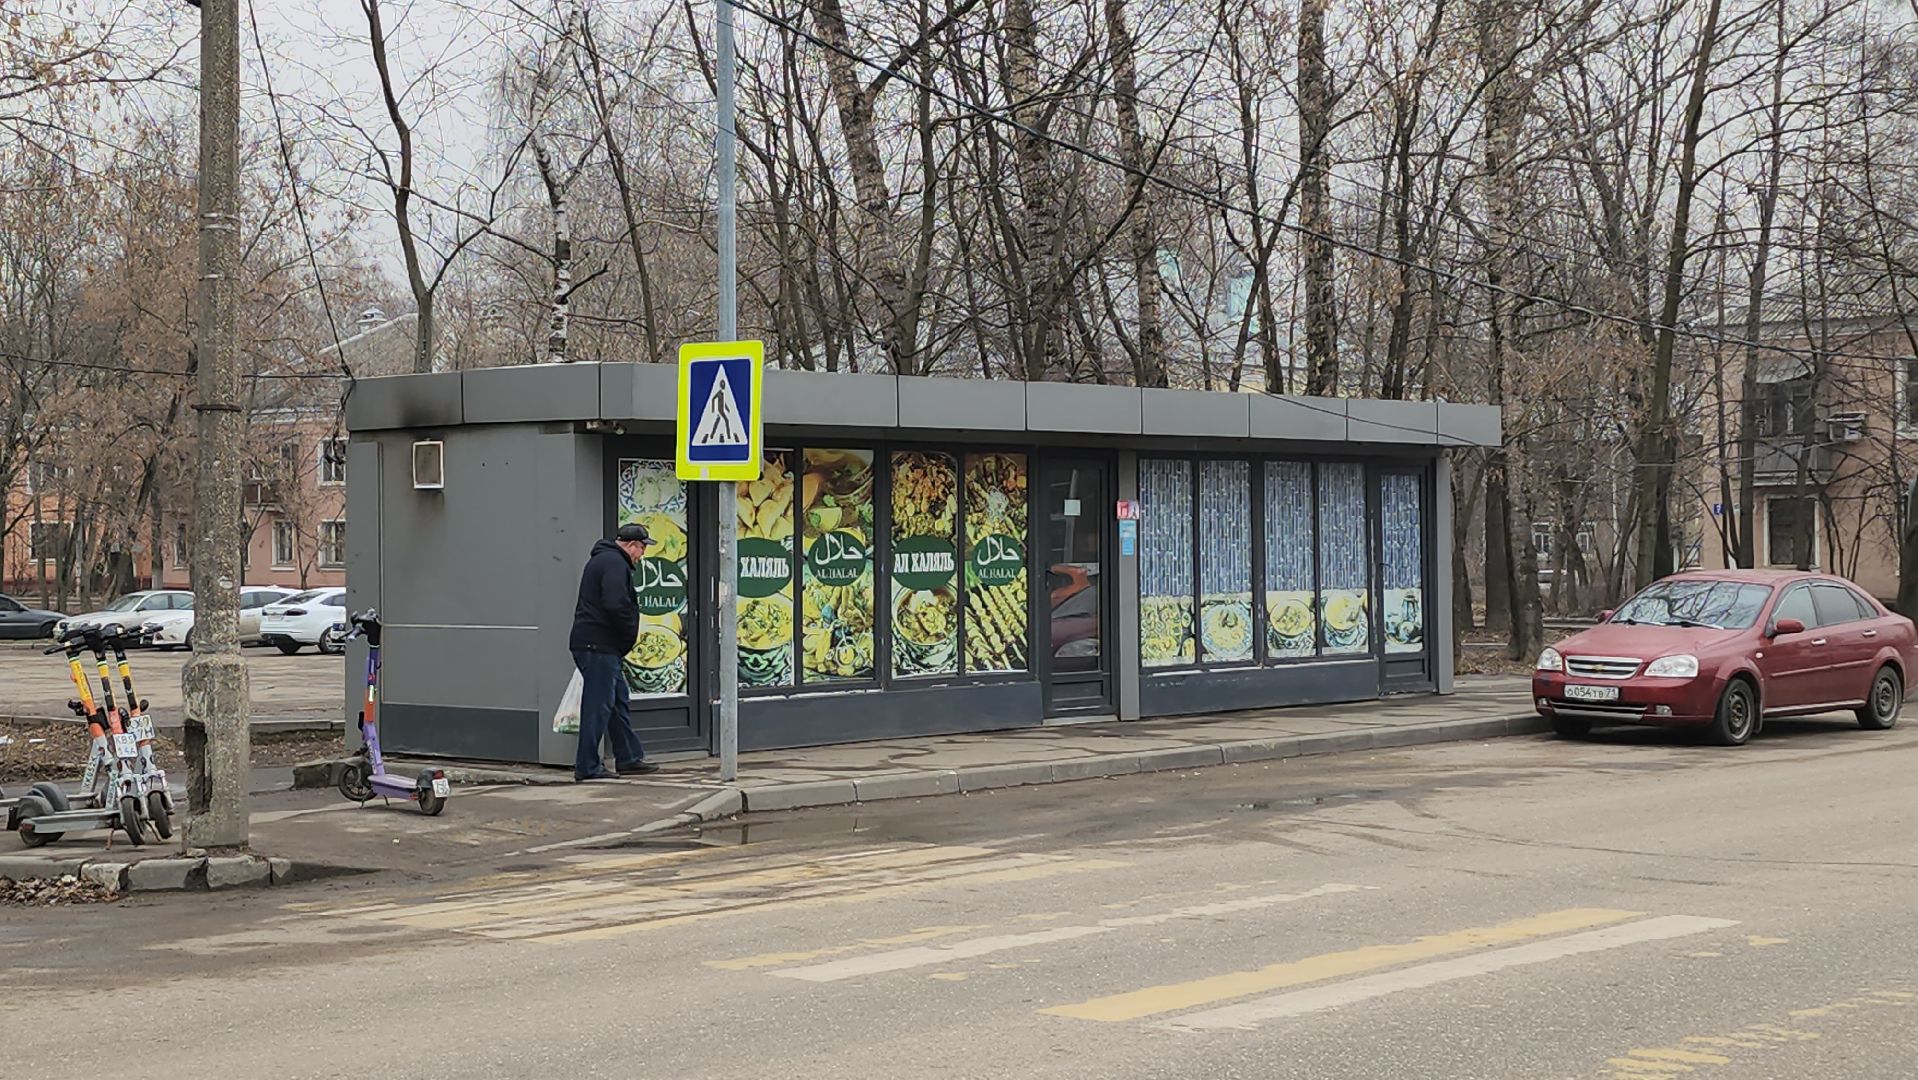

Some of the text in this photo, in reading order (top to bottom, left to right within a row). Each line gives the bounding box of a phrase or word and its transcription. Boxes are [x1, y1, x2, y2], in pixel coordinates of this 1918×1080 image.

[815, 533, 863, 566] حلال
[977, 536, 1020, 566] حلال
[740, 556, 790, 578] ХАЛЯЛЬ
[830, 567, 858, 579] HALAL
[893, 552, 955, 573] АЛ ХАЛЯЛЬ
[990, 568, 1015, 578] HALAL
[644, 596, 679, 607] HALAL
